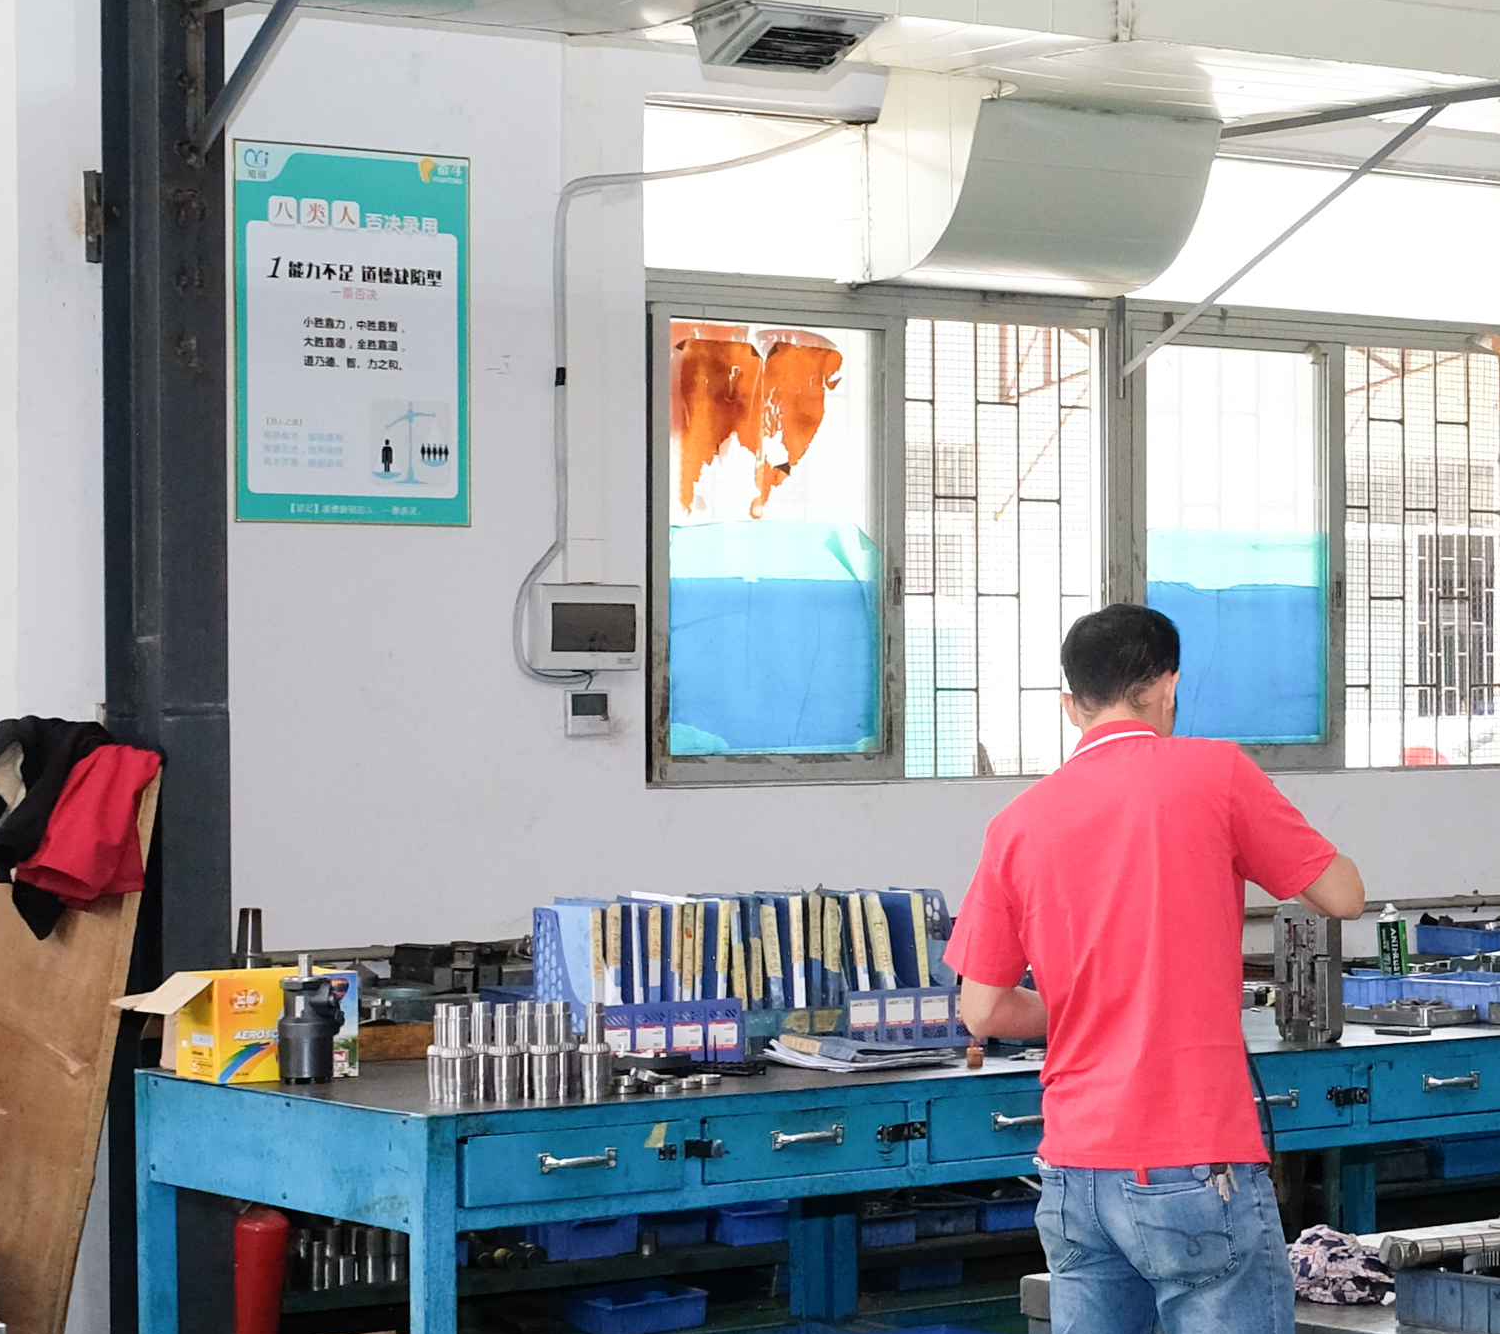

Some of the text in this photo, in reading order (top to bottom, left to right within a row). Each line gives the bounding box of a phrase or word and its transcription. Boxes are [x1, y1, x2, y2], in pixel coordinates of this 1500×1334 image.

[274, 201, 439, 235] 八类人 否决录用
[267, 256, 442, 287] 1 能力不足 道德缺陷型
[330, 287, 378, 301] 一票否决
[234, 1030, 279, 1042] AEROSO
